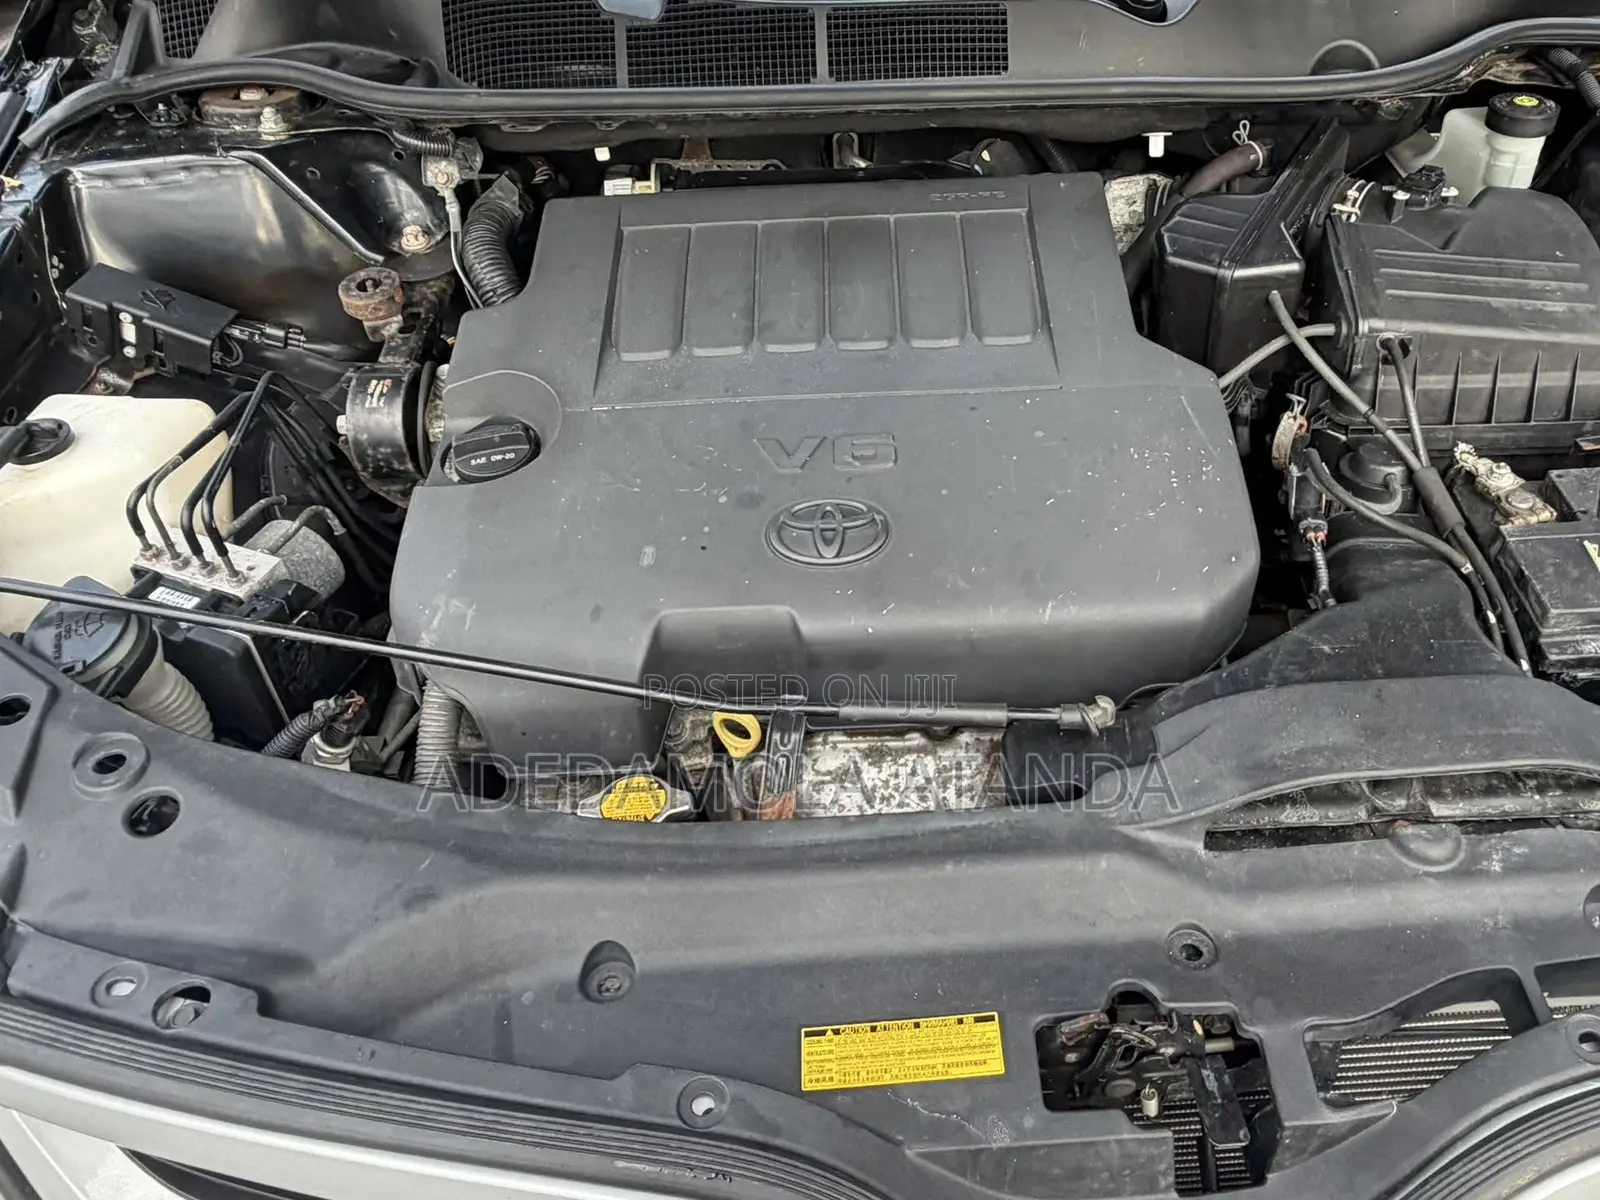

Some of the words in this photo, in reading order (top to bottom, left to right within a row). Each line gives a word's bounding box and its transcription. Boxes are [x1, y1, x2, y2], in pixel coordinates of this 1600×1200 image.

[470, 456, 487, 466] SAE
[490, 452, 515, 462] 0W-20
[753, 433, 898, 474] V6
[839, 1025, 871, 1035] CAUTION
[876, 1022, 914, 1032] ATTENTION
